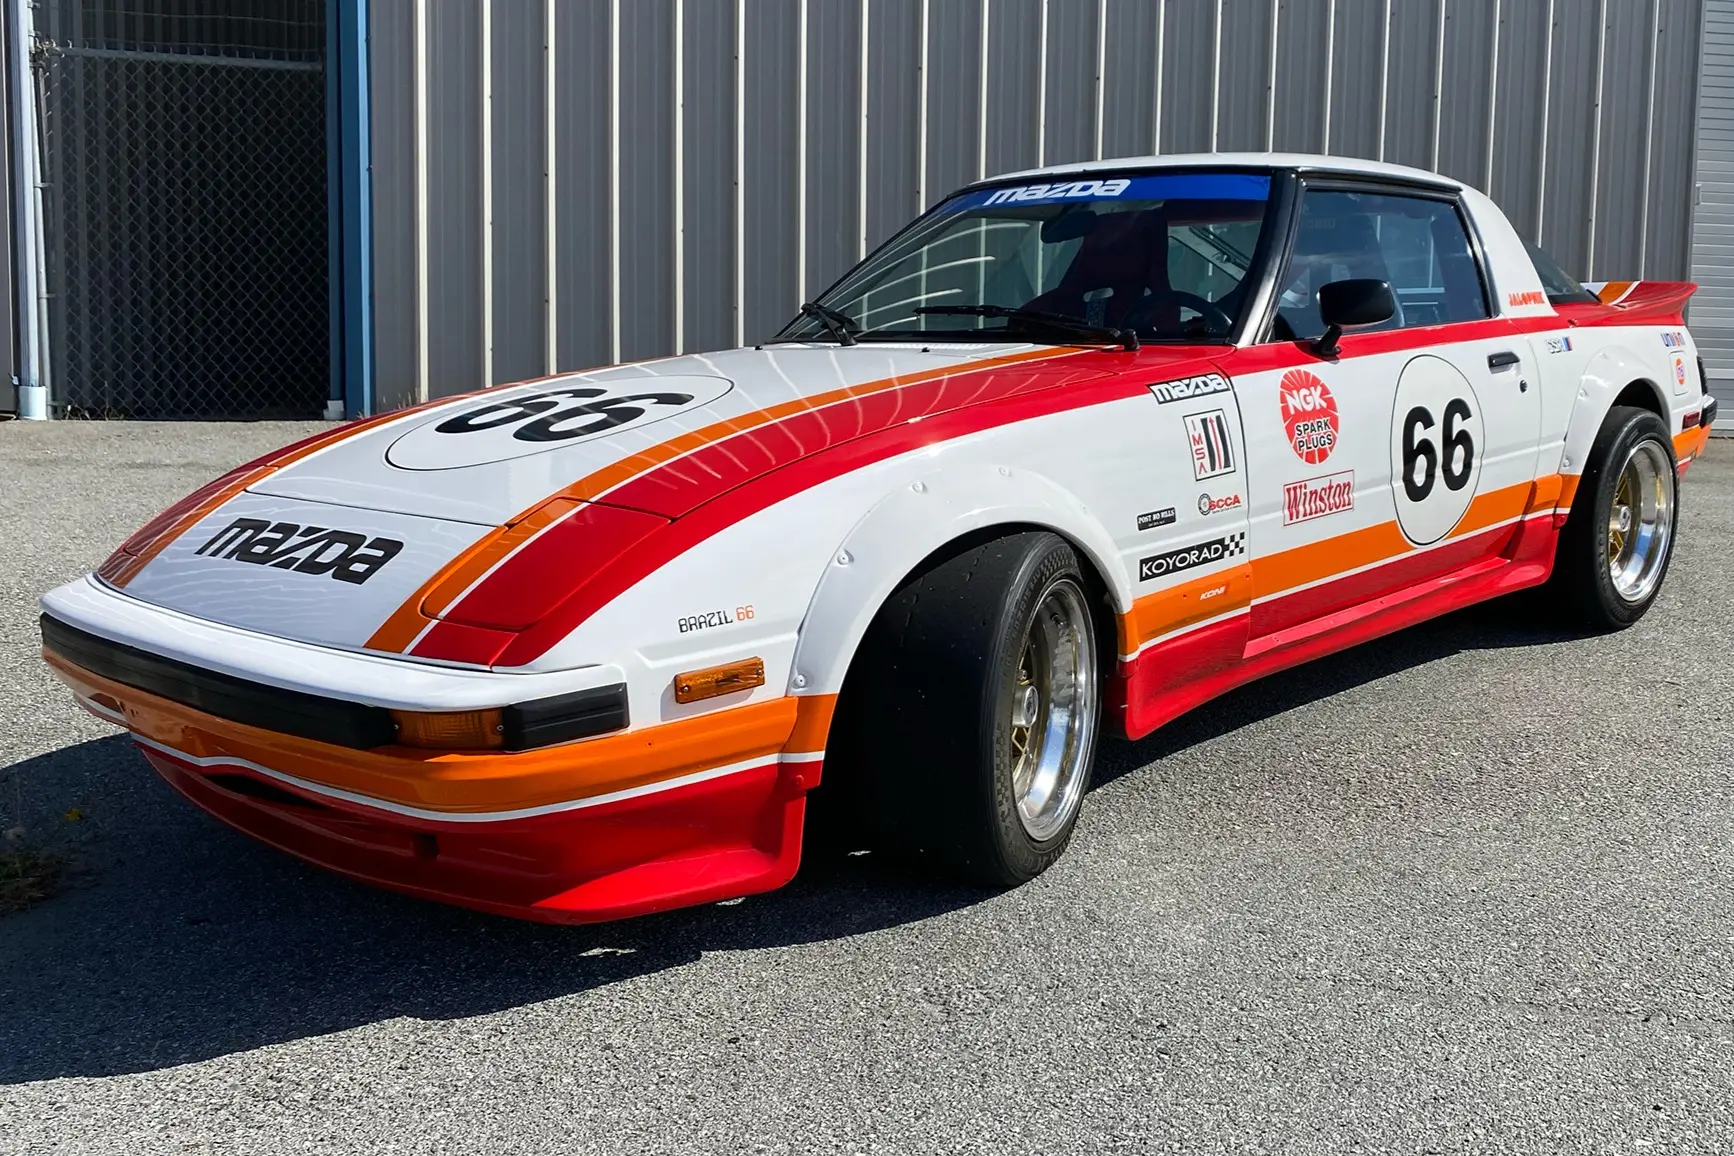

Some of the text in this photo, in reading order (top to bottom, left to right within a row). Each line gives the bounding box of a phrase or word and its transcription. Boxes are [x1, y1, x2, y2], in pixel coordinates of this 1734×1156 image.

[983, 179, 1131, 206] mazda
[1149, 373, 1229, 402] mazda
[1285, 386, 1327, 415] NGK
[434, 388, 694, 442] 66
[1296, 419, 1331, 437] SPARK
[1298, 434, 1333, 451] PLUGS
[1402, 398, 1474, 502] 66
[1209, 494, 1241, 511] SCCA
[1286, 479, 1352, 521] Winston
[195, 518, 404, 585] mazda
[1142, 544, 1223, 577] KOYORAD
[1200, 586, 1226, 600] KONI
[678, 604, 755, 633] BRAZIL 66
